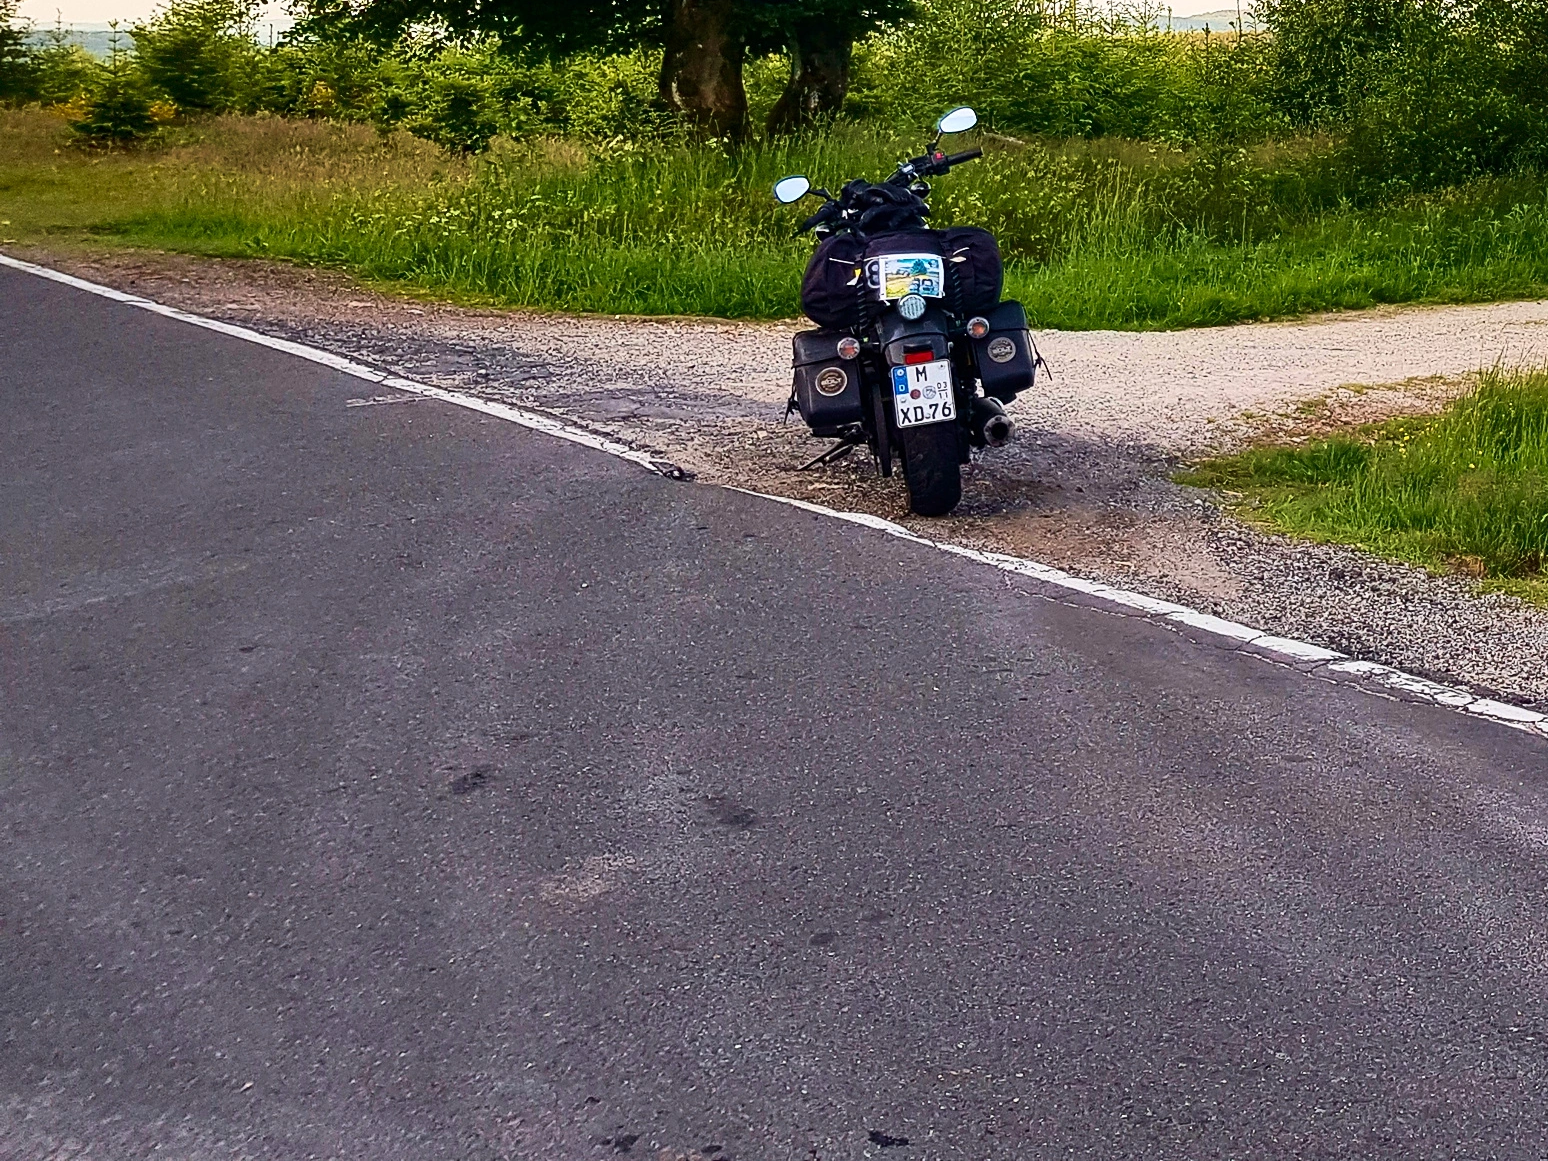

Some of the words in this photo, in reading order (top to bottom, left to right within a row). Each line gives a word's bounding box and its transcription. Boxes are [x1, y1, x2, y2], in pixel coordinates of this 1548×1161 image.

[915, 365, 928, 382] M
[898, 384, 906, 392] D
[936, 381, 948, 389] 03
[928, 401, 952, 420] 76
